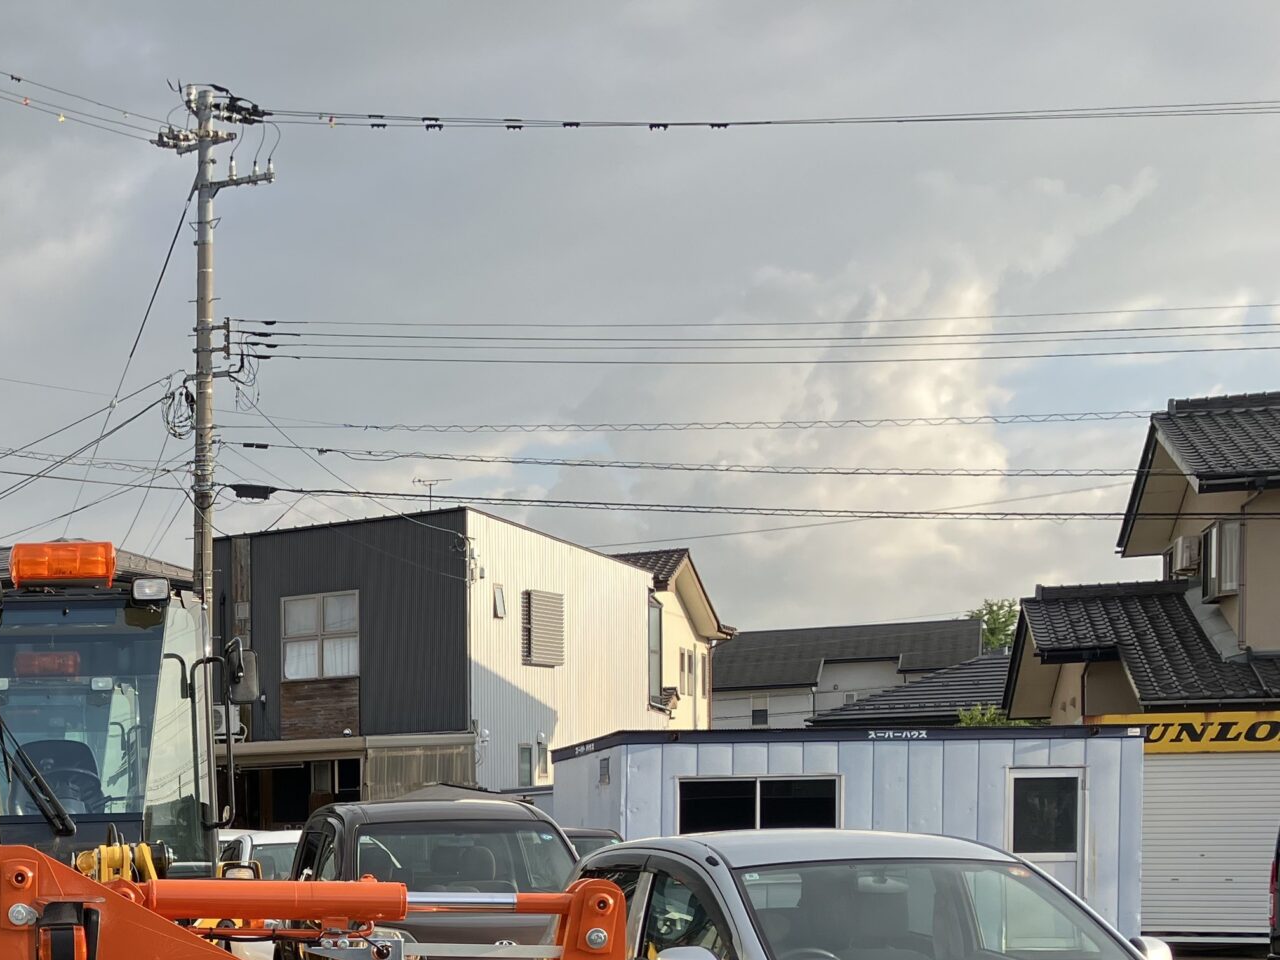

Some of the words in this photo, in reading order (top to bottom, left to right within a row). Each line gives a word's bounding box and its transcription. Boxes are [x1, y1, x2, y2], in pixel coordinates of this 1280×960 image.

[867, 730, 928, 739] スーパーハウス
[1147, 720, 1280, 744] UNLO
